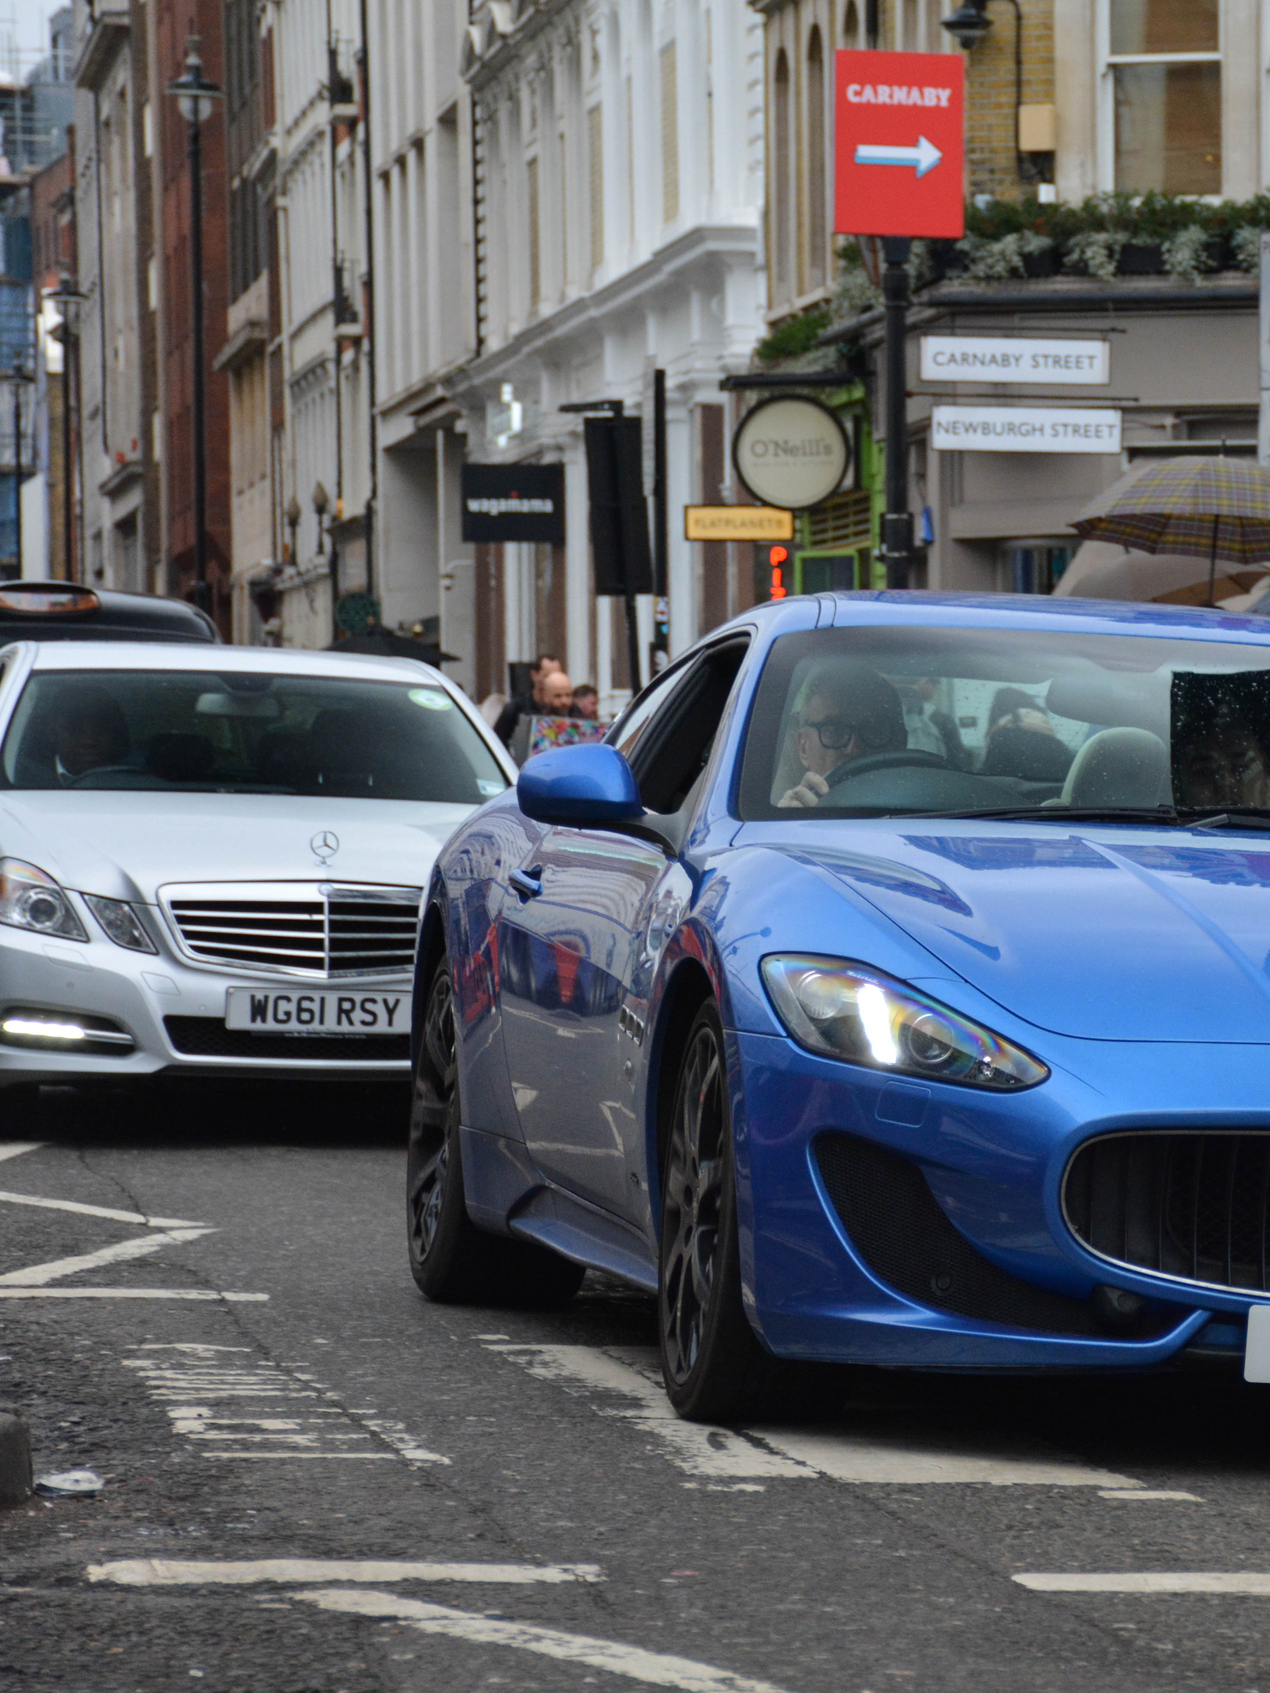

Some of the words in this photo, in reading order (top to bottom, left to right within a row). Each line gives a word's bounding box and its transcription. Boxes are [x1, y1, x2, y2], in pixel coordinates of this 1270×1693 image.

[846, 83, 952, 107] CARNABY
[932, 352, 1023, 368] CARNABY
[1031, 354, 1097, 369] STREET
[936, 420, 1045, 437] NEWBURGH
[1051, 423, 1117, 439] STREET
[751, 437, 832, 458] O'Neill's
[251, 995, 325, 1025] WG61
[337, 997, 400, 1027] RSY
